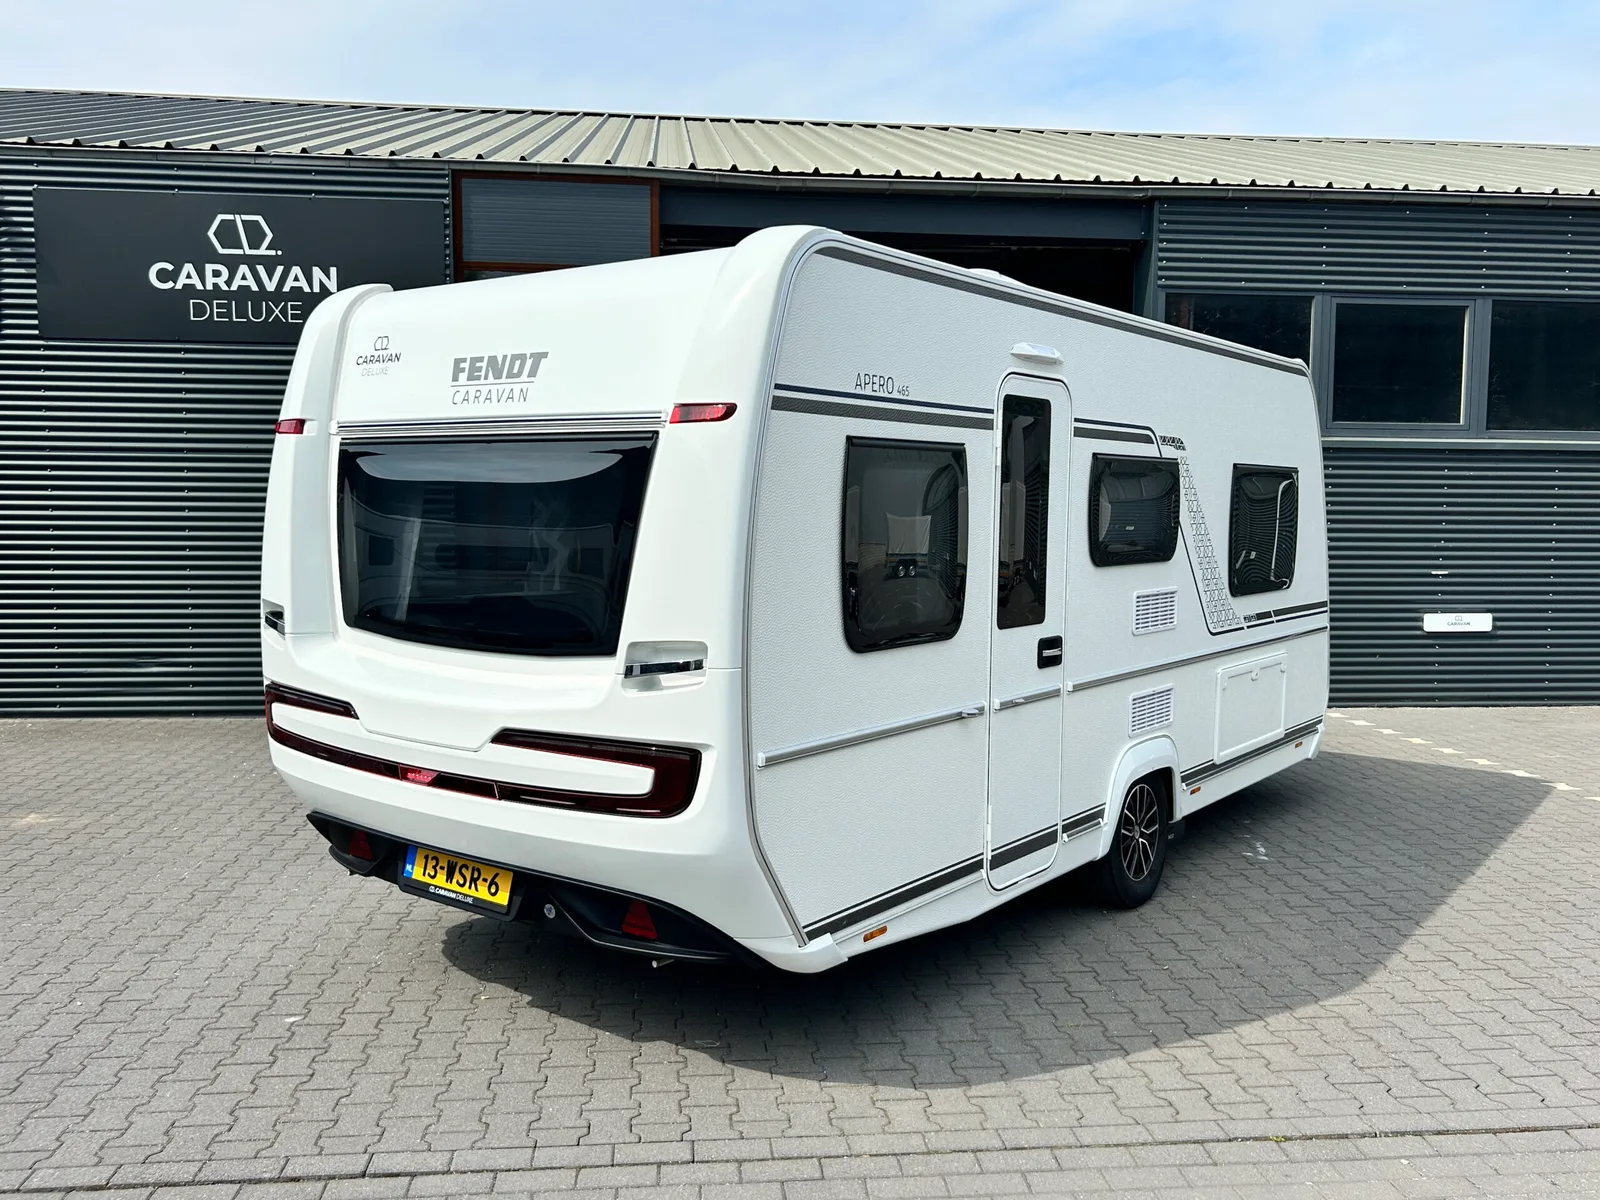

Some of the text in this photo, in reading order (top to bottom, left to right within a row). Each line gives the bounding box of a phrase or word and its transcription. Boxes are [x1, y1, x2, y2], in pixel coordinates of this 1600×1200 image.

[148, 261, 338, 293] CARAVAN
[189, 299, 303, 323] DELUXE
[356, 352, 402, 366] CARAVAN
[451, 351, 549, 382] FENDT
[361, 366, 390, 377] DELUXE
[854, 372, 910, 397] APERO 465
[451, 387, 529, 406] CARAVAN
[405, 863, 413, 873] NL
[422, 853, 500, 897] 13-WSR-6
[435, 887, 457, 899] CARAVAN
[456, 893, 474, 904] DELUXE
